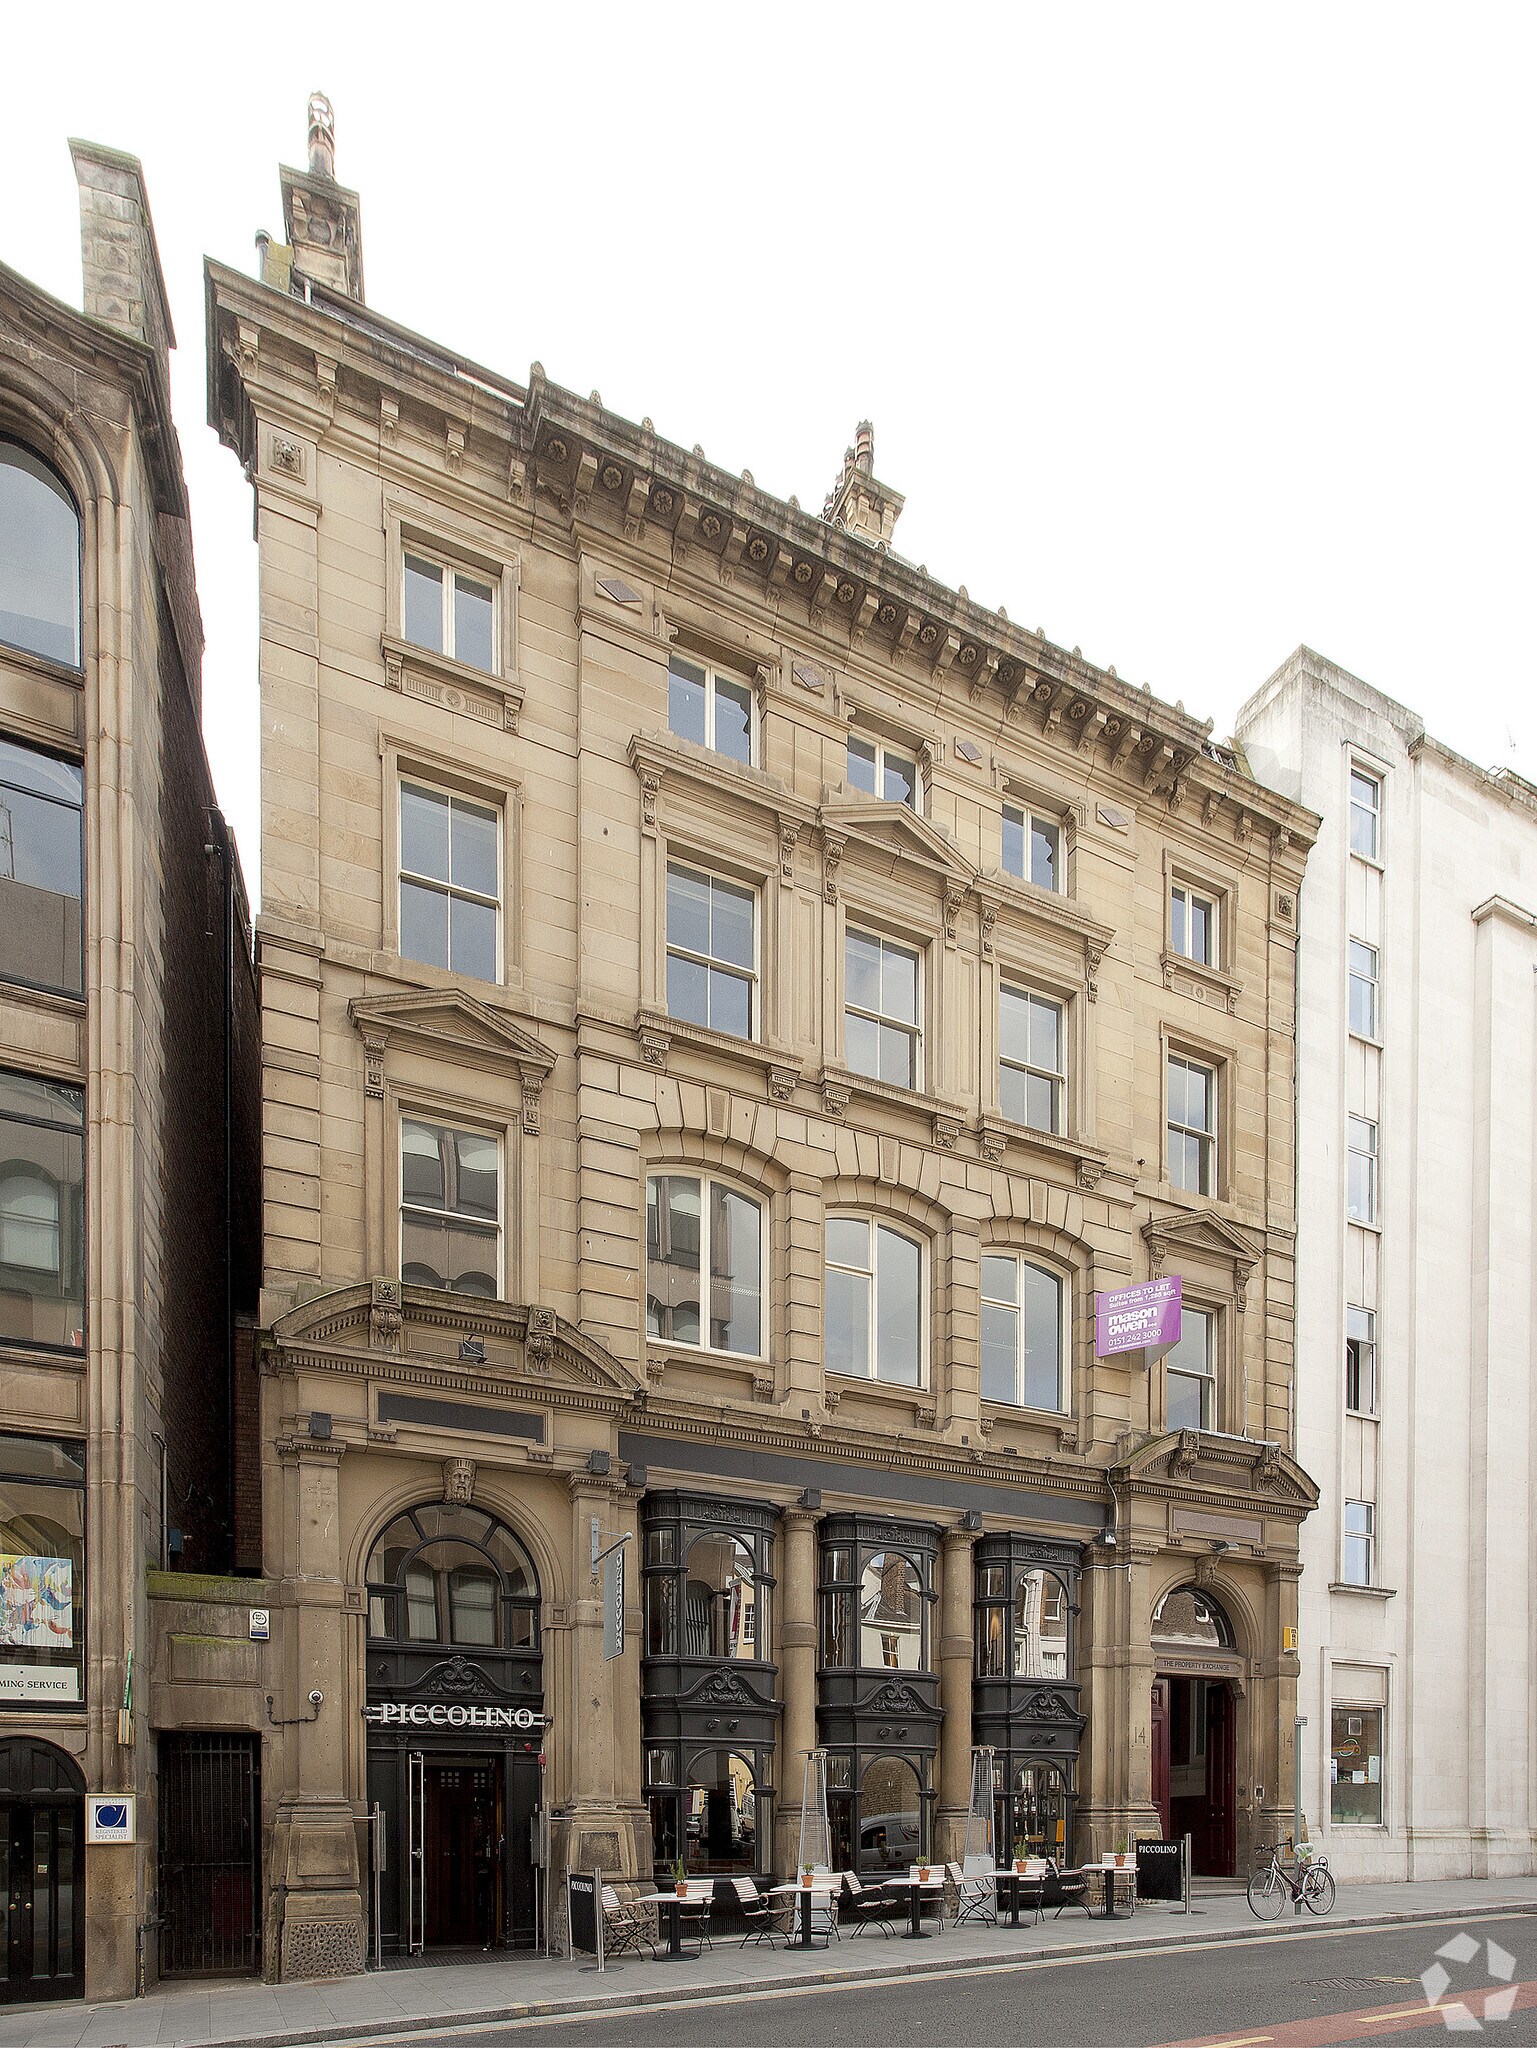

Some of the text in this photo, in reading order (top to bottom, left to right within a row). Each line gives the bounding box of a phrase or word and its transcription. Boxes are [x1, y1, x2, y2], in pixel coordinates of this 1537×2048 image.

[1108, 1283, 1171, 1303] OFFICES TO LET
[1108, 1299, 1128, 1309] Suites
[1129, 1296, 1144, 1304] from
[1108, 1306, 1158, 1327] mason
[1108, 1329, 1162, 1347] 0151 242 3000
[1174, 1661, 1202, 1669] PROPERTY
[1202, 1662, 1230, 1671] EXCHANGE
[27, 1681, 68, 1690] SERVICE
[380, 1703, 535, 1729] PICCOLINO
[1134, 1726, 1146, 1744] 14
[1283, 1732, 1294, 1749] 14
[1138, 1845, 1178, 1854] PICCOLINO
[571, 1880, 593, 1893] PICCOLINO
